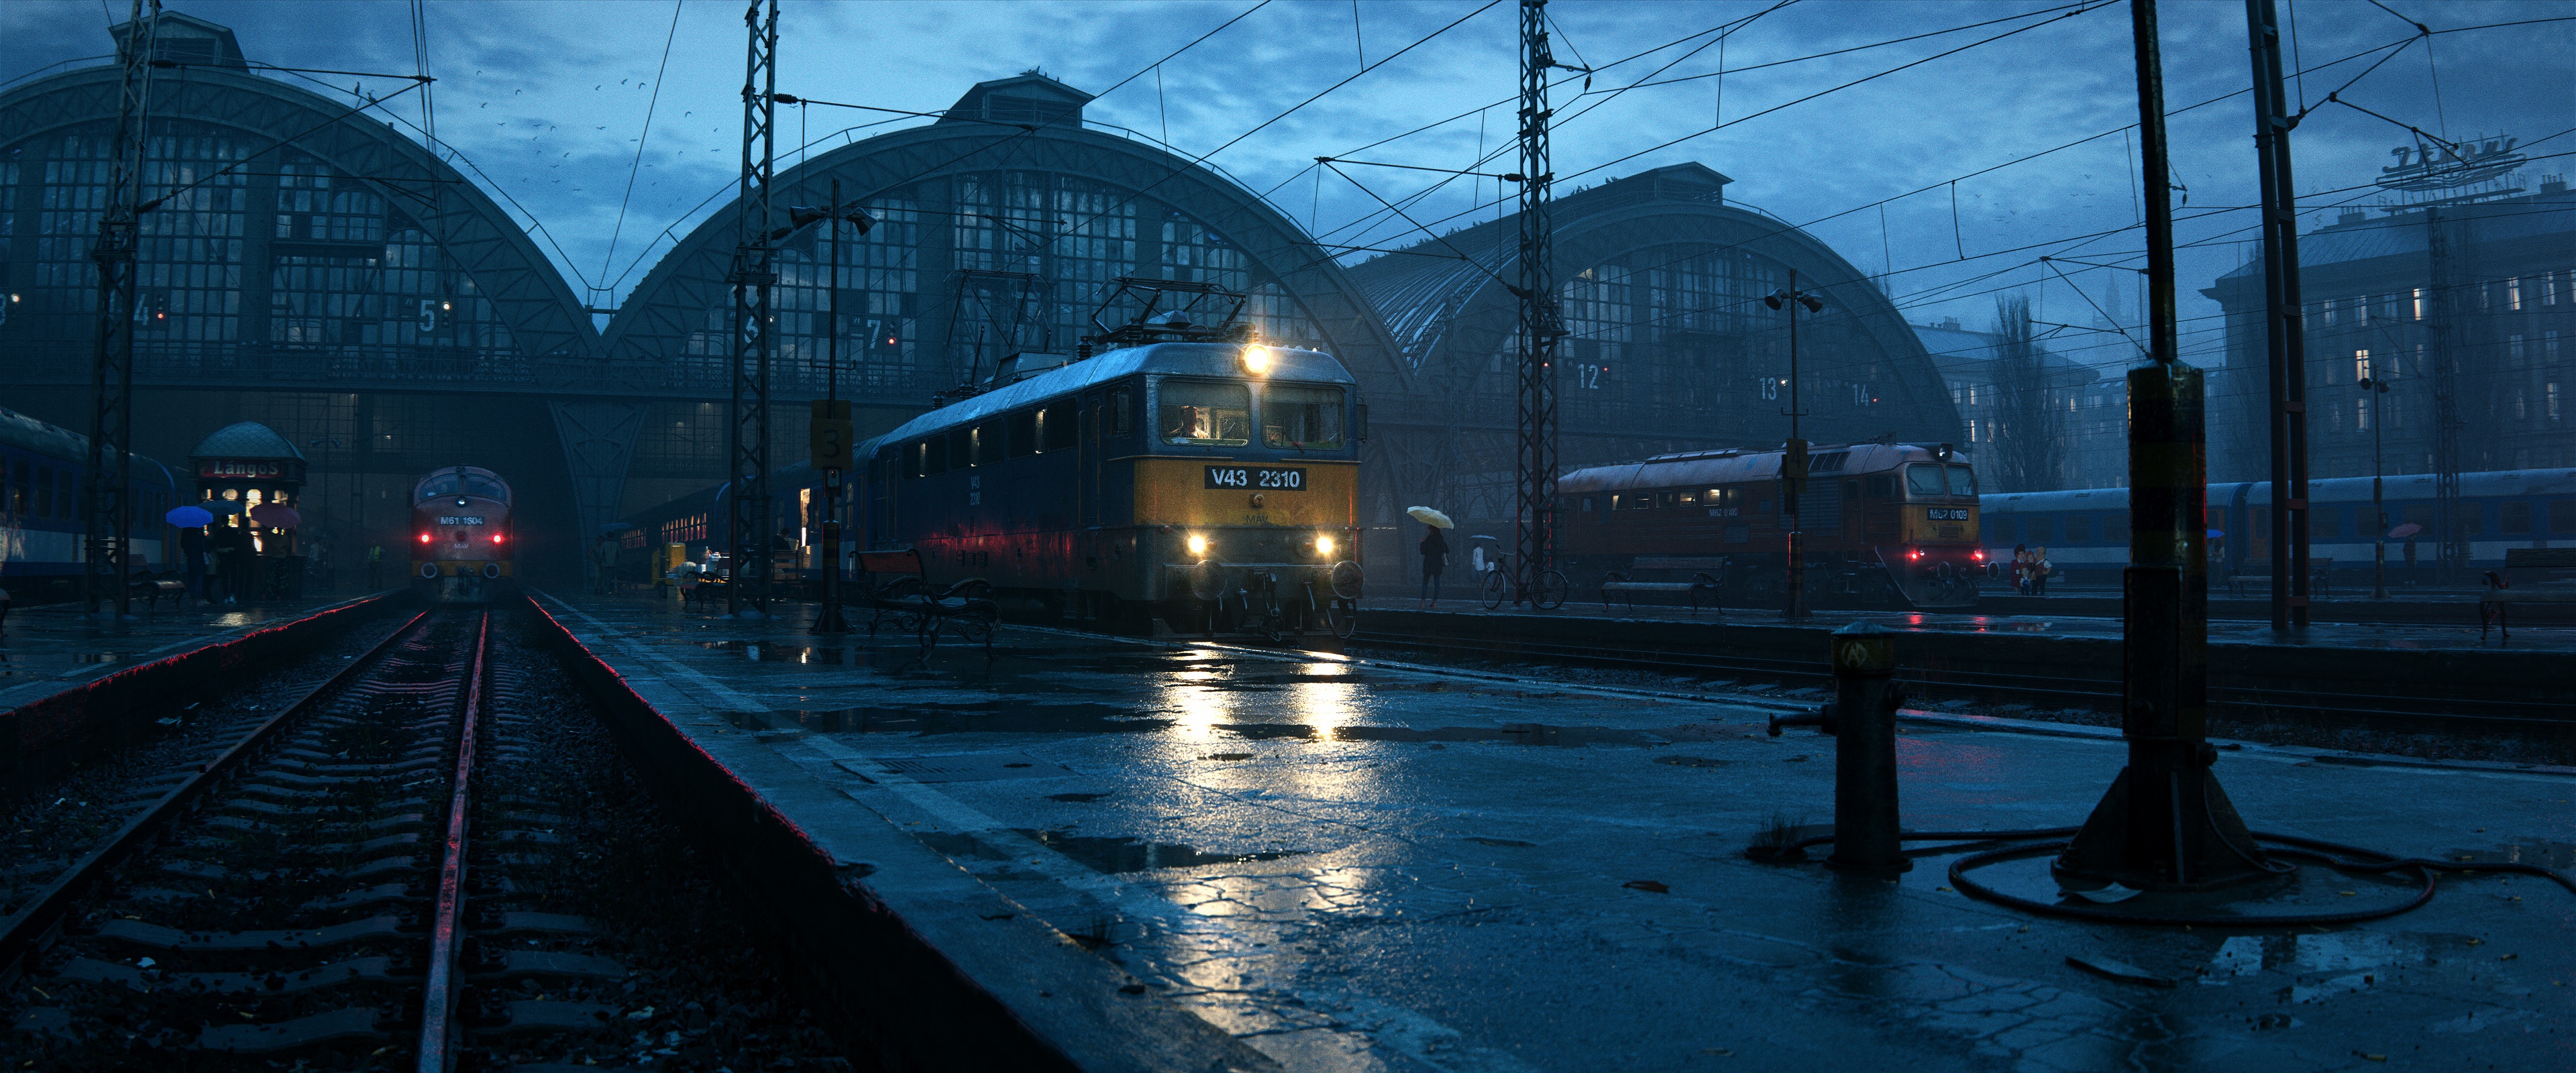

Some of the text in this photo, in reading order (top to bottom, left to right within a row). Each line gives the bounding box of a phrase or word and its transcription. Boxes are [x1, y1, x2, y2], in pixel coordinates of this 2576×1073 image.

[133, 294, 149, 325] 4
[419, 299, 435, 332] 5
[744, 315, 759, 344] 6
[867, 319, 881, 349] 7
[1578, 363, 1599, 390] 12
[1759, 377, 1777, 400] 13
[1852, 384, 1869, 406] 14
[823, 429, 841, 459] 3
[1790, 446, 1802, 469] 4
[970, 474, 980, 490] V43
[1212, 468, 1300, 488] V43 2310
[969, 490, 981, 506] 2310
[440, 516, 460, 525] M61
[1709, 508, 1722, 517] M62
[1950, 509, 1968, 520] 0109
